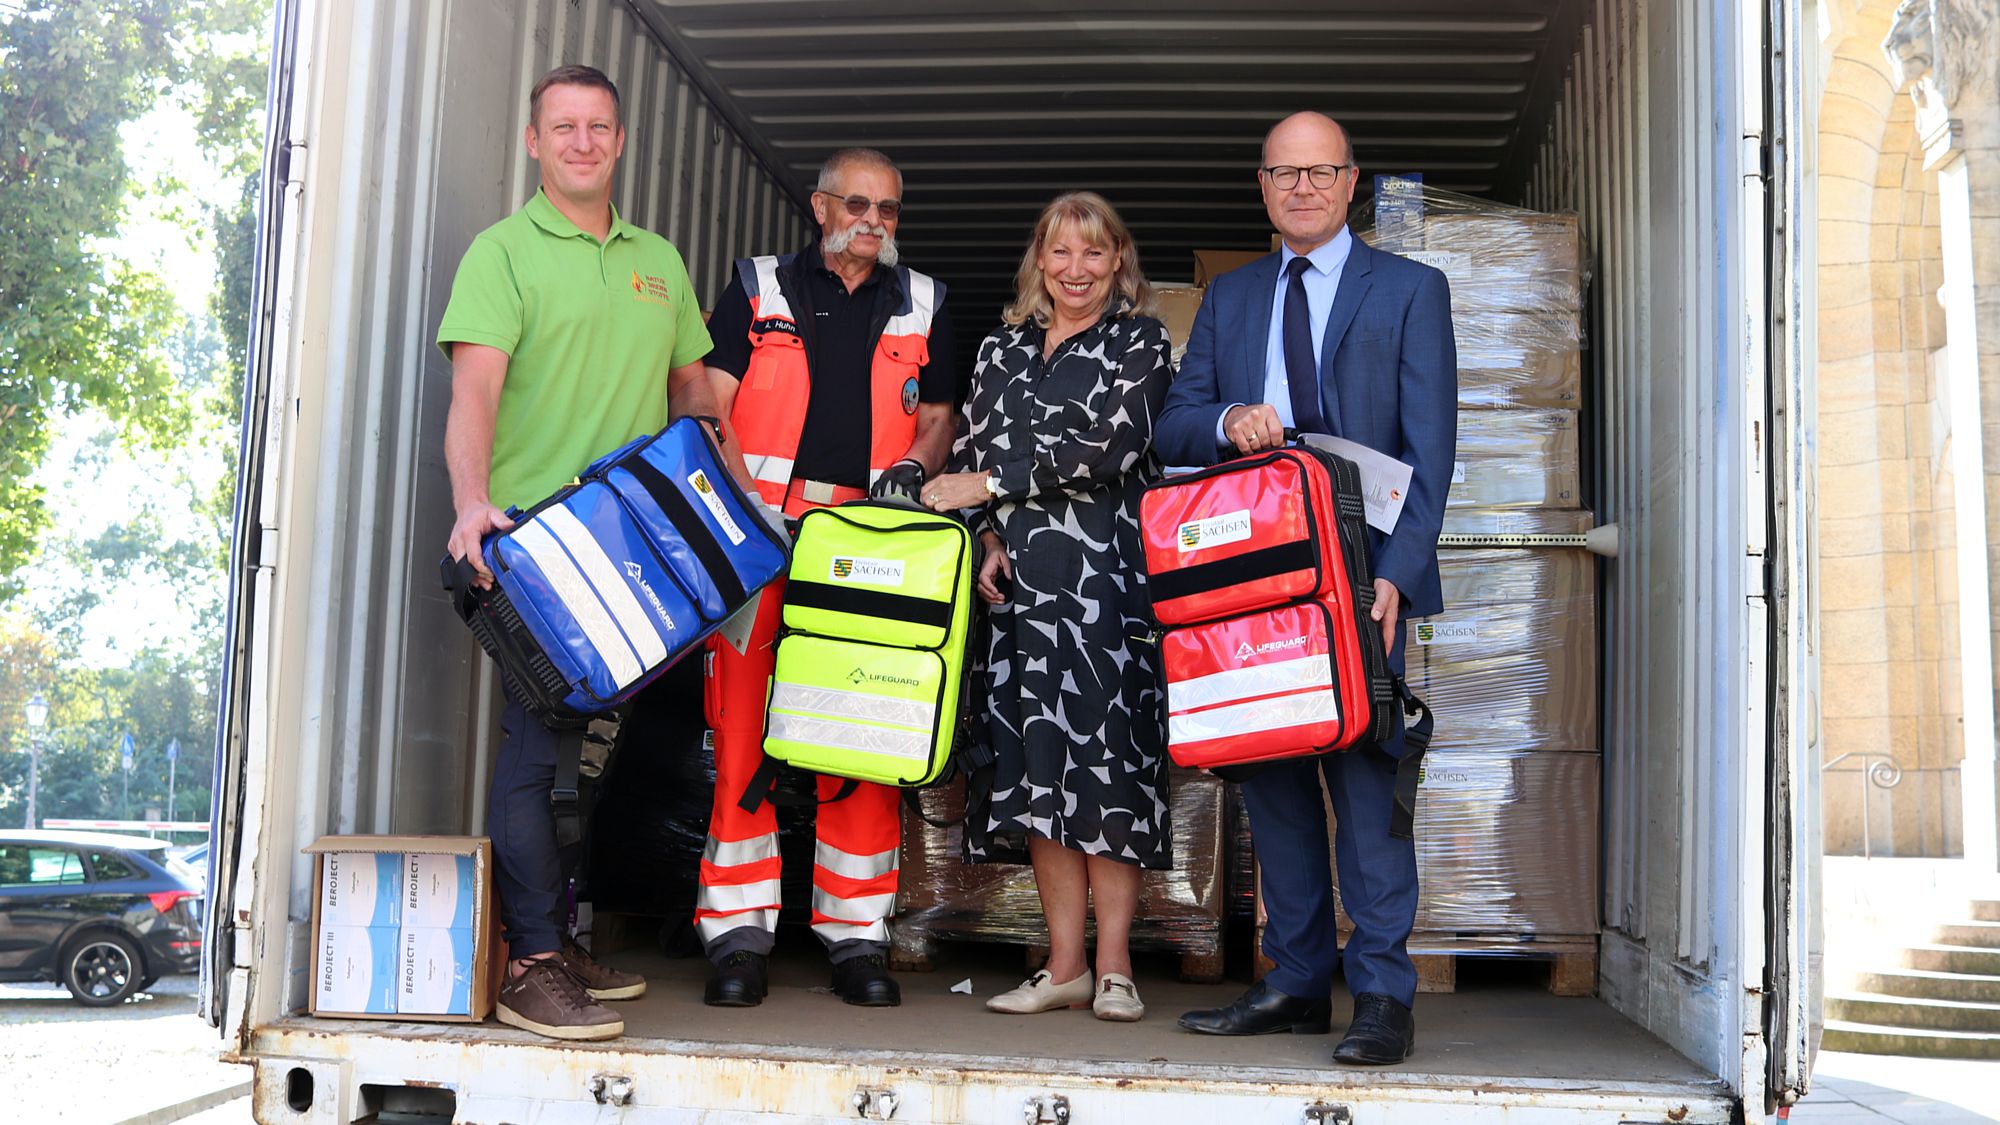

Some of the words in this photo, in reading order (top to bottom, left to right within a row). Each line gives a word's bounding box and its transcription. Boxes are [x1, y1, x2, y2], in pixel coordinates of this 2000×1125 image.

[1202, 520, 1248, 537] SACHSEN
[854, 565, 901, 577] SACHSEN
[1434, 627, 1476, 637] SACHSEN
[869, 674, 920, 687] LIFEGUARD
[1427, 773, 1468, 782] SACHSEN
[327, 931, 335, 942] III
[407, 933, 415, 943] III
